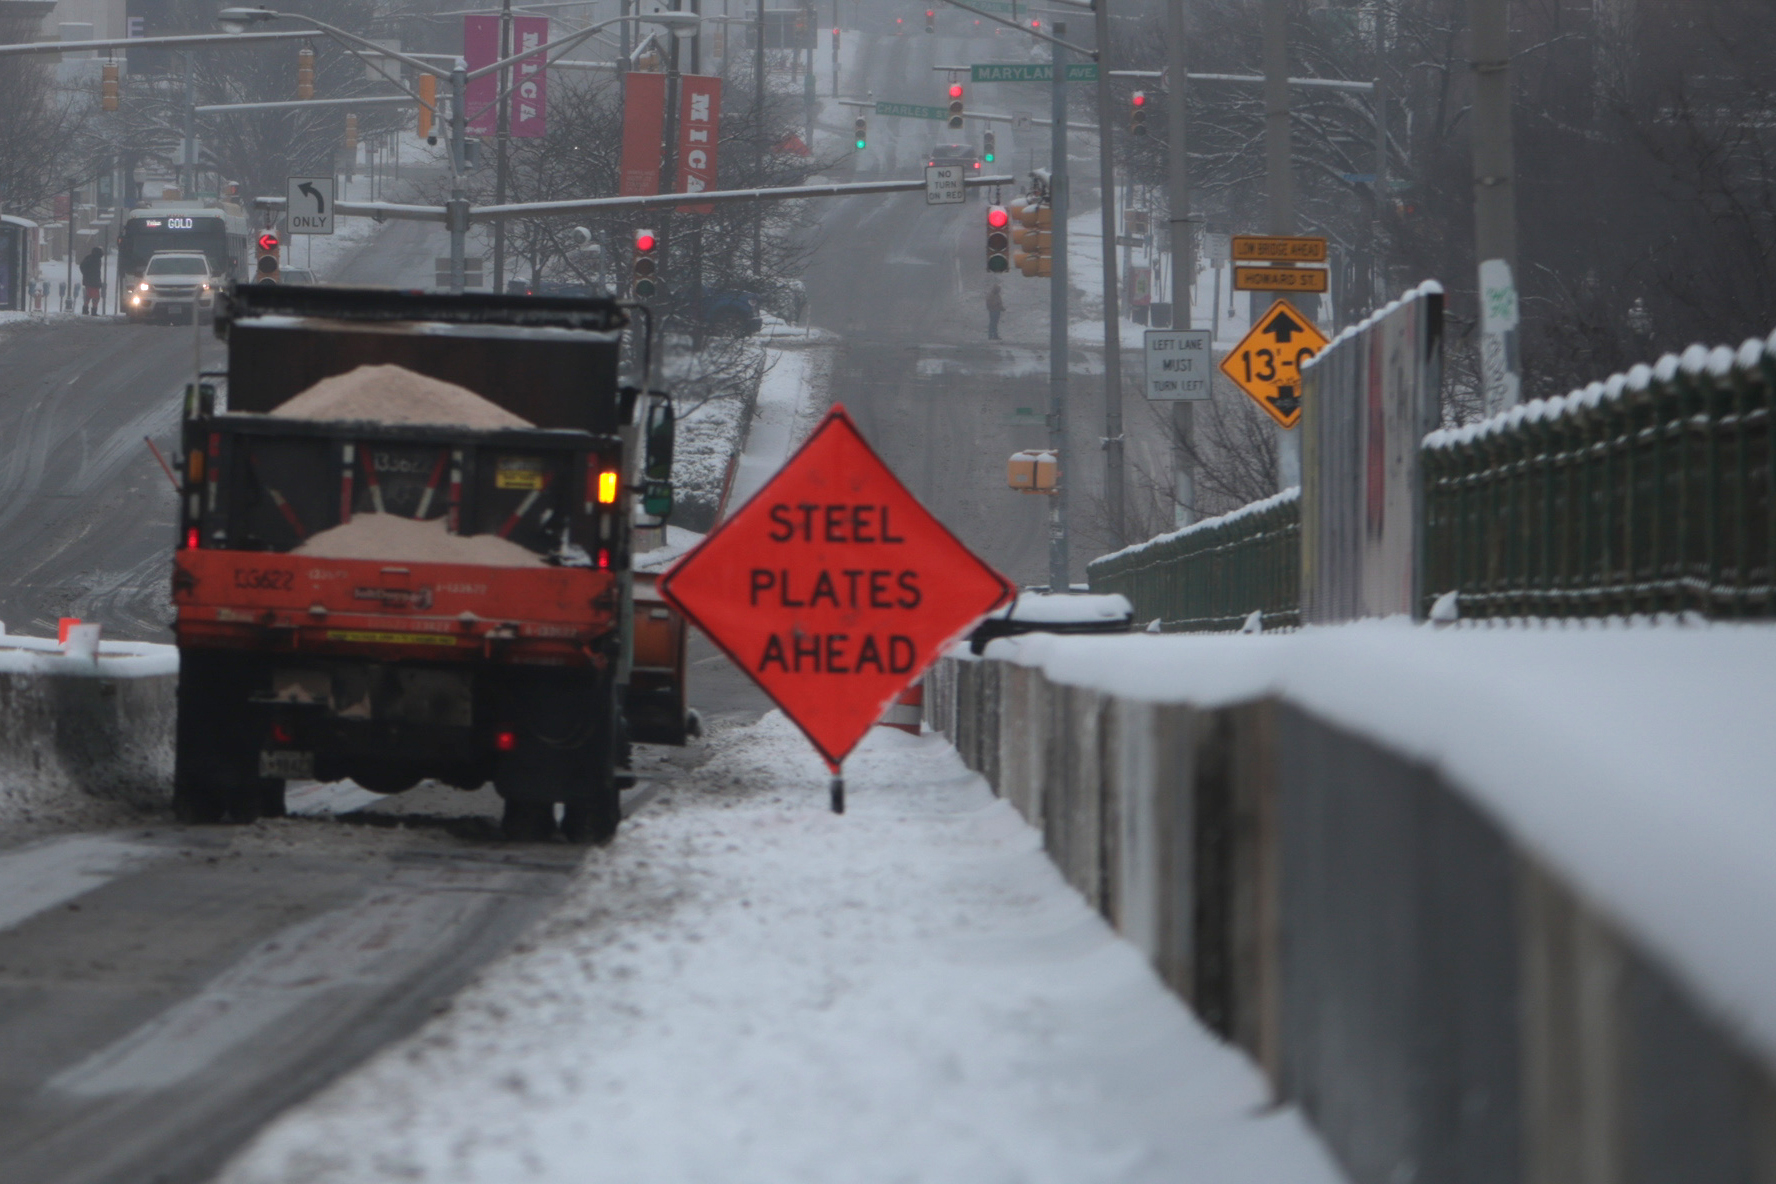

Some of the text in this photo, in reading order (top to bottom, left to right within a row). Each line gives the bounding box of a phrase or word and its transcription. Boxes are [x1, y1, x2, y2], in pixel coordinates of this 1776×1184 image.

[978, 68, 1096, 80] MARYLAN AVE.
[876, 103, 929, 117] CHARLES
[937, 170, 952, 178] NO
[934, 181, 957, 189] TURN
[928, 191, 963, 200] ON RED
[167, 218, 193, 229] GOLD
[292, 216, 328, 228] ONLY
[1257, 245, 1288, 256] BRIDGE
[1291, 245, 1319, 257] AHEAD
[1244, 275, 1296, 286] HOWARD
[1152, 339, 1204, 351] LEFT LANE
[1162, 359, 1193, 372] MUST
[1153, 380, 1204, 392] TURN LEFT
[769, 504, 904, 544] STEEL
[750, 569, 922, 609] PLATES
[757, 635, 917, 674] AHEAD
